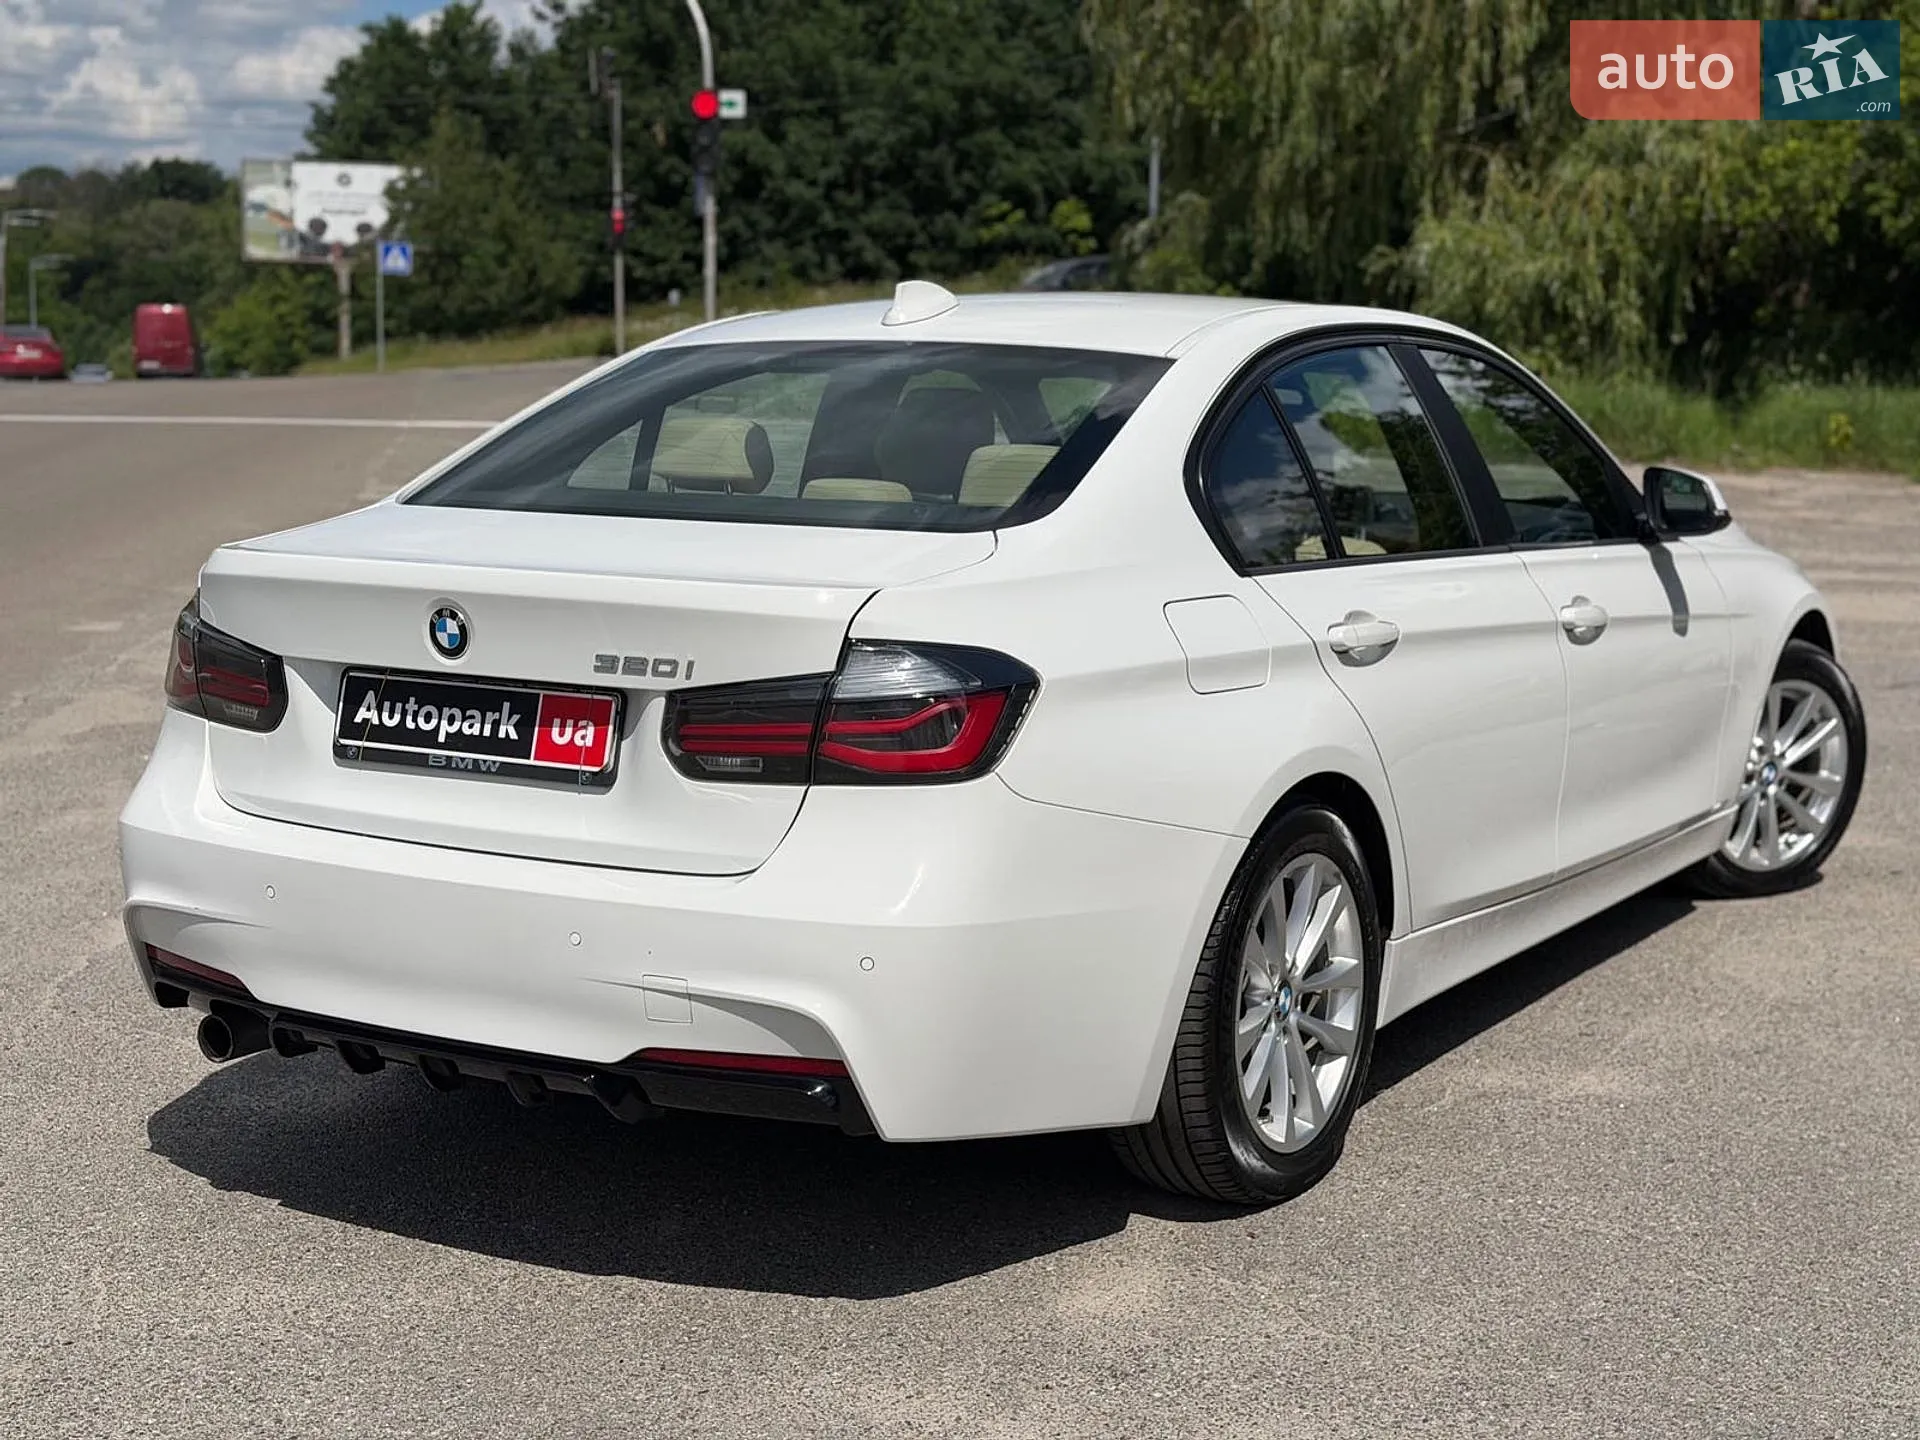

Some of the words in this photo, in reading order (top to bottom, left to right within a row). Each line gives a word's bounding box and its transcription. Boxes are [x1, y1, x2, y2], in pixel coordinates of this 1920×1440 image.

[353, 689, 522, 743] Autopark
[550, 714, 595, 748] ua
[427, 754, 502, 774] BMW
